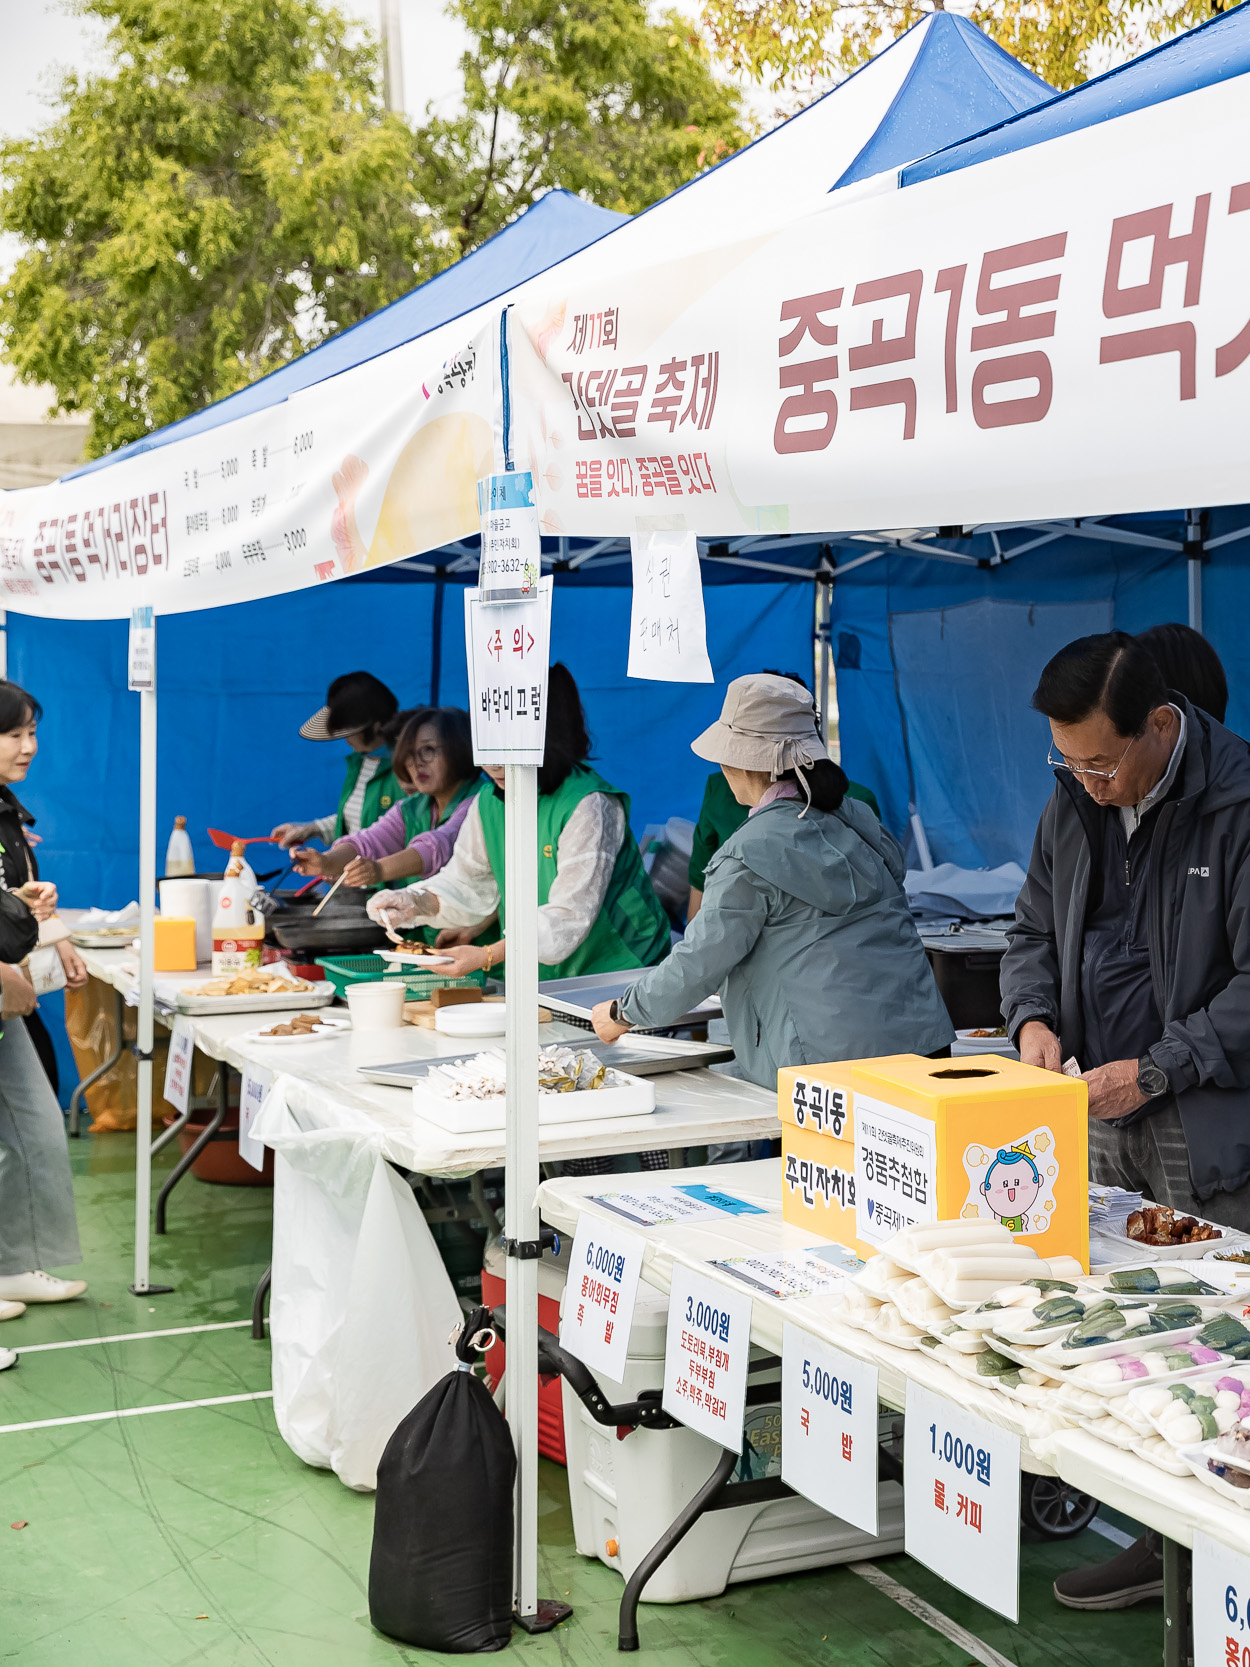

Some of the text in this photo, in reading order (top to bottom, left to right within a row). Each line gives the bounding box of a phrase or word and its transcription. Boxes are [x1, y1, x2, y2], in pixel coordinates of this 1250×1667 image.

[566, 307, 619, 354] 제11회
[774, 231, 1068, 455] 중곡1동
[647, 351, 719, 433] 축제
[576, 452, 717, 498] 꿈을 잇다, 중곡을 잇다
[82, 490, 168, 581] 먹거리장터
[284, 527, 307, 556] 3,000
[640, 617, 682, 654] 판매처
[482, 684, 541, 722] 바닥미끄럼
[861, 1122, 877, 1138] 제11회
[861, 1146, 928, 1205] 경품추첨함
[587, 1242, 625, 1283] 6,000원
[581, 1274, 619, 1314] 홍어회무침
[686, 1296, 730, 1343] 3,000원
[689, 1359, 715, 1389] 두부부침
[802, 1360, 852, 1415] 5,000원
[929, 1423, 990, 1487] 1,000원
[956, 1492, 982, 1534] 커피
